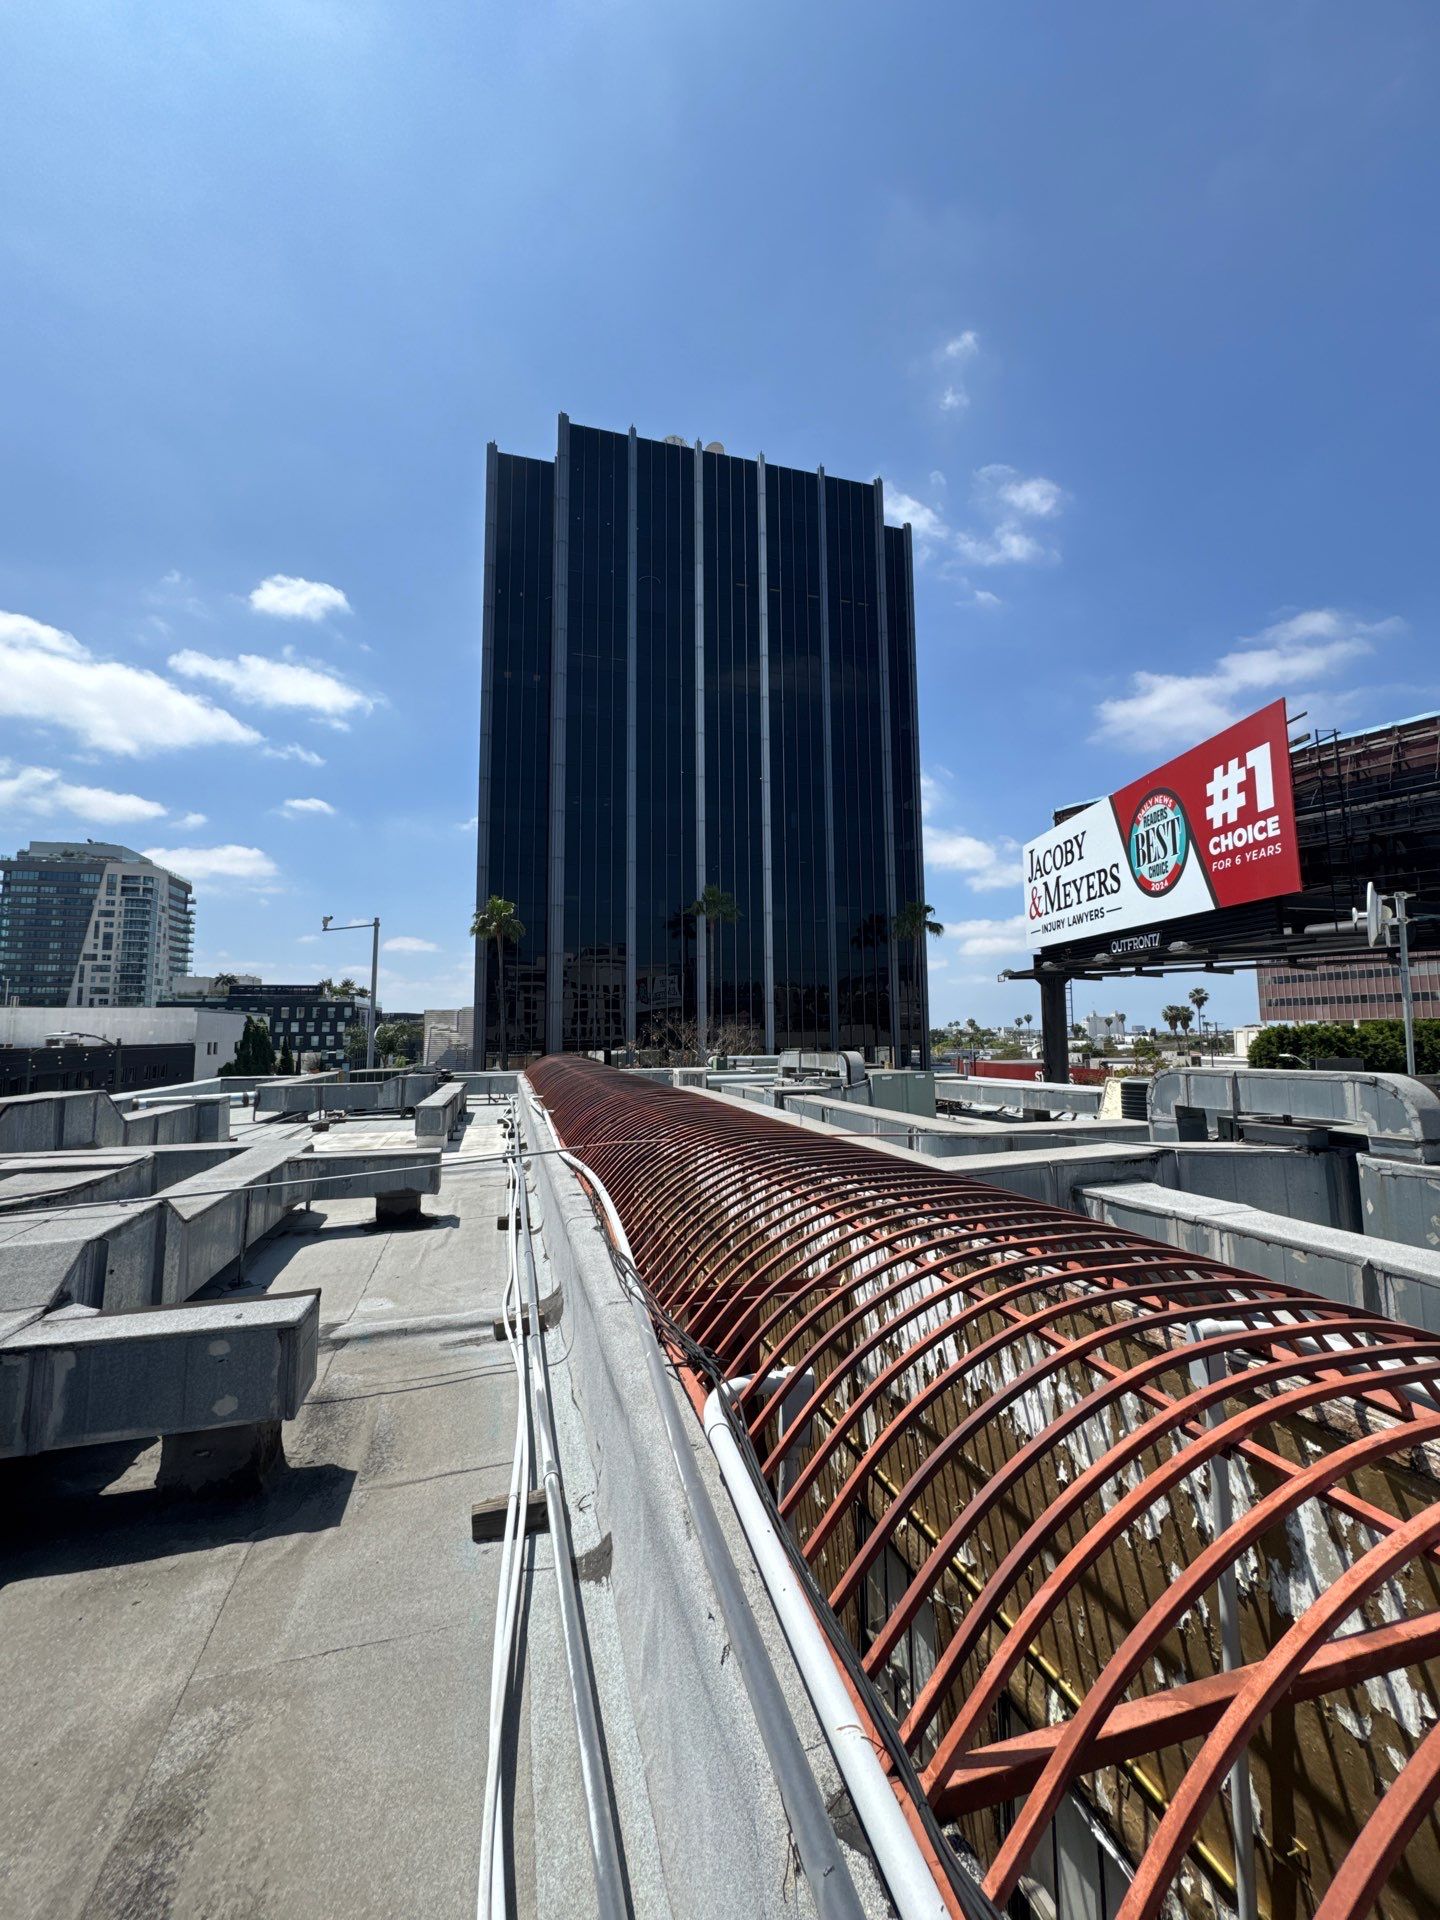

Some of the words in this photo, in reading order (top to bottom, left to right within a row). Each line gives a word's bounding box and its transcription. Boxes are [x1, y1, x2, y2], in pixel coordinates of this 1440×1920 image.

[1205, 741, 1275, 829] #1
[1137, 799, 1153, 820] DAILY
[1154, 795, 1173, 808] NEWS
[1134, 815, 1180, 868] BEST
[1208, 815, 1281, 856] CHOICE
[1028, 830, 1086, 883] JACOBY
[1148, 861, 1169, 878] CHOICE
[1212, 858, 1232, 872] FOR
[1235, 854, 1242, 865] 6
[1245, 842, 1282, 862] YEARS
[1151, 880, 1168, 891] 2024
[1041, 919, 1065, 934] INJURY
[1067, 907, 1105, 927] LAWYERS
